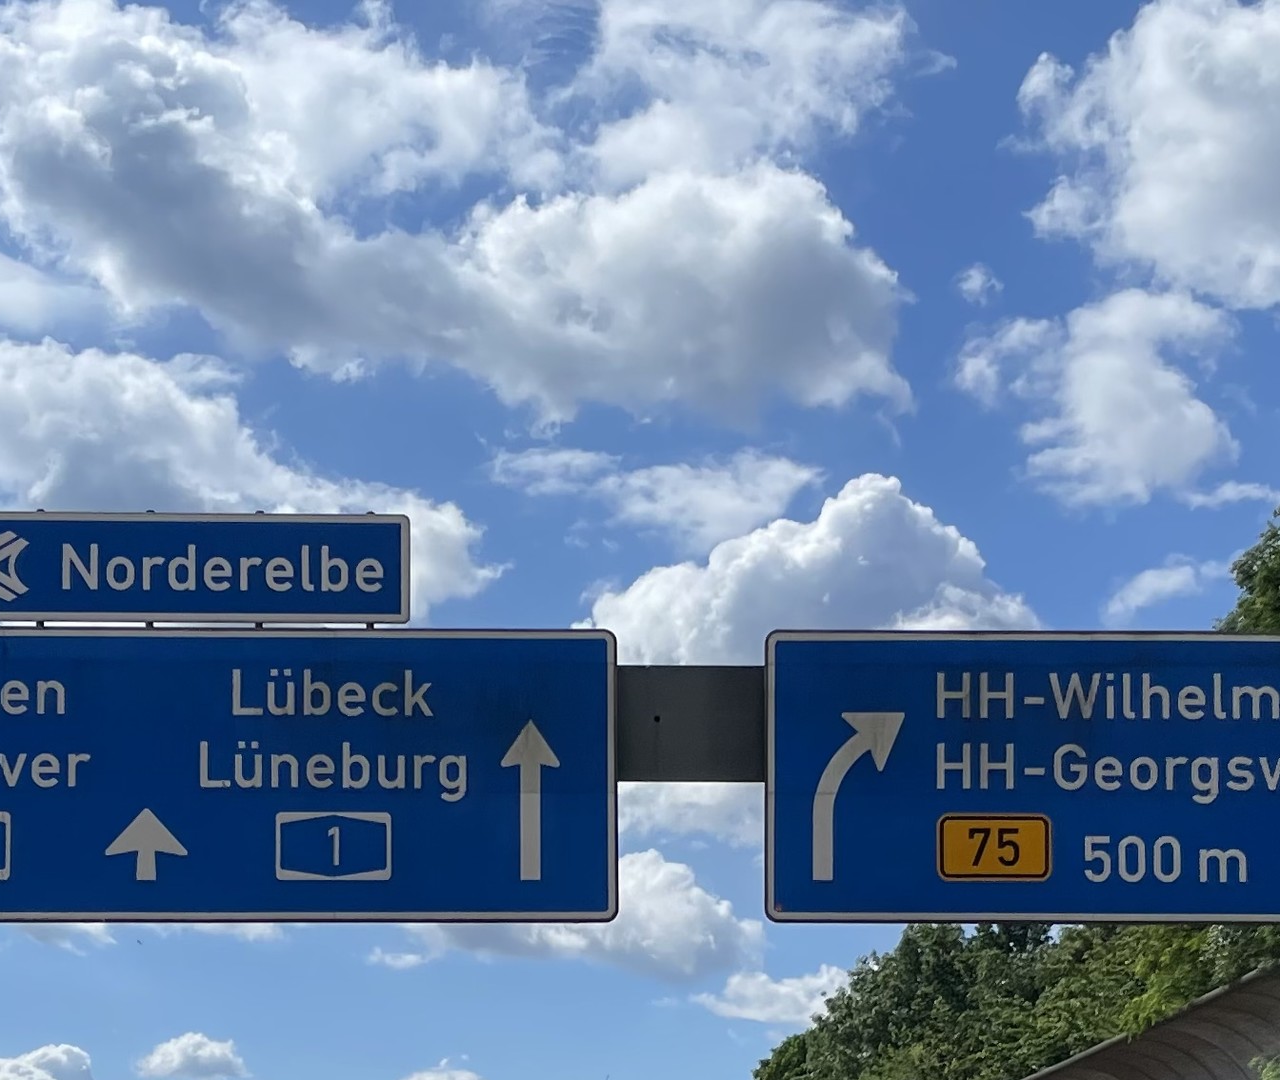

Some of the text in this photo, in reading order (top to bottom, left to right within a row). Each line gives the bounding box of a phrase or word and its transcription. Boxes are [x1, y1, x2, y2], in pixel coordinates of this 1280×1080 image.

[63, 544, 385, 593] Norderelbe
[233, 669, 434, 717] Lübeck
[200, 742, 468, 802] Lüneburg
[328, 827, 341, 866] 1
[968, 827, 1021, 868] 75
[1085, 836, 1248, 883] 500 m
